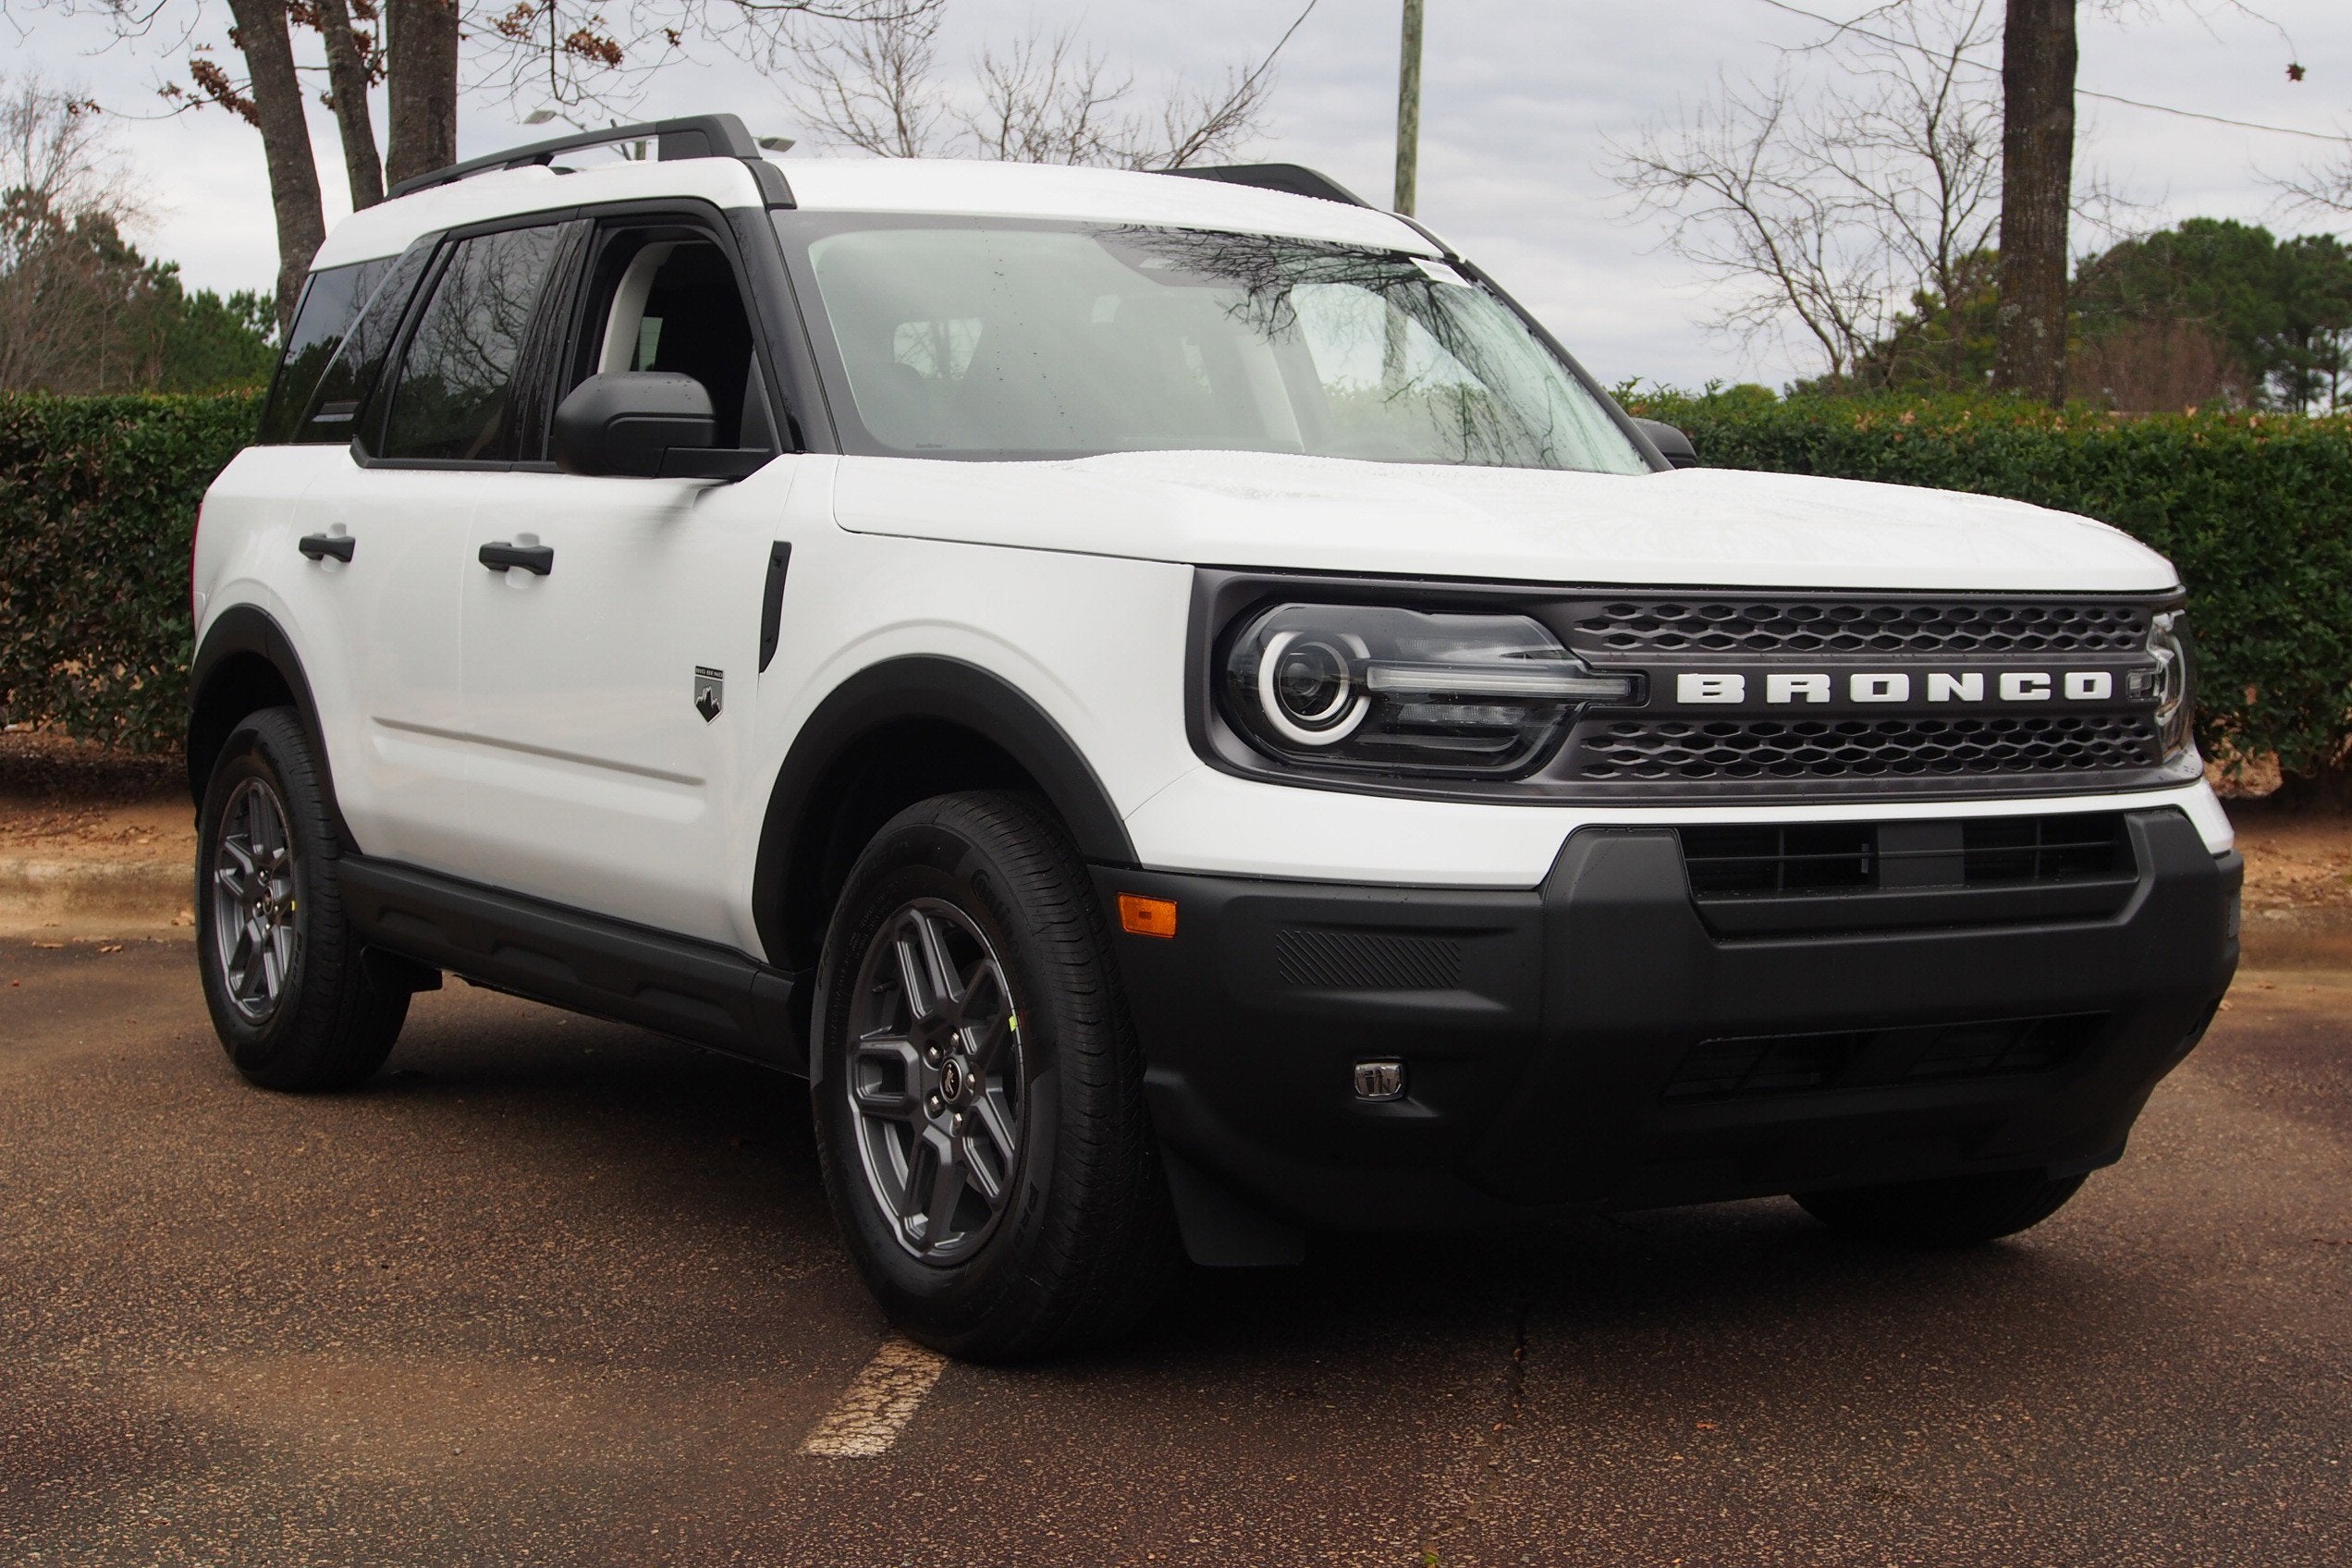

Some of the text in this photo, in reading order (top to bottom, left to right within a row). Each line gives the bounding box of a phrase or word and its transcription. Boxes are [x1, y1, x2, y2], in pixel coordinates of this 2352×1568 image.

[695, 667, 723, 679] BIG BEND
[1676, 671, 2113, 704] BRONCO
